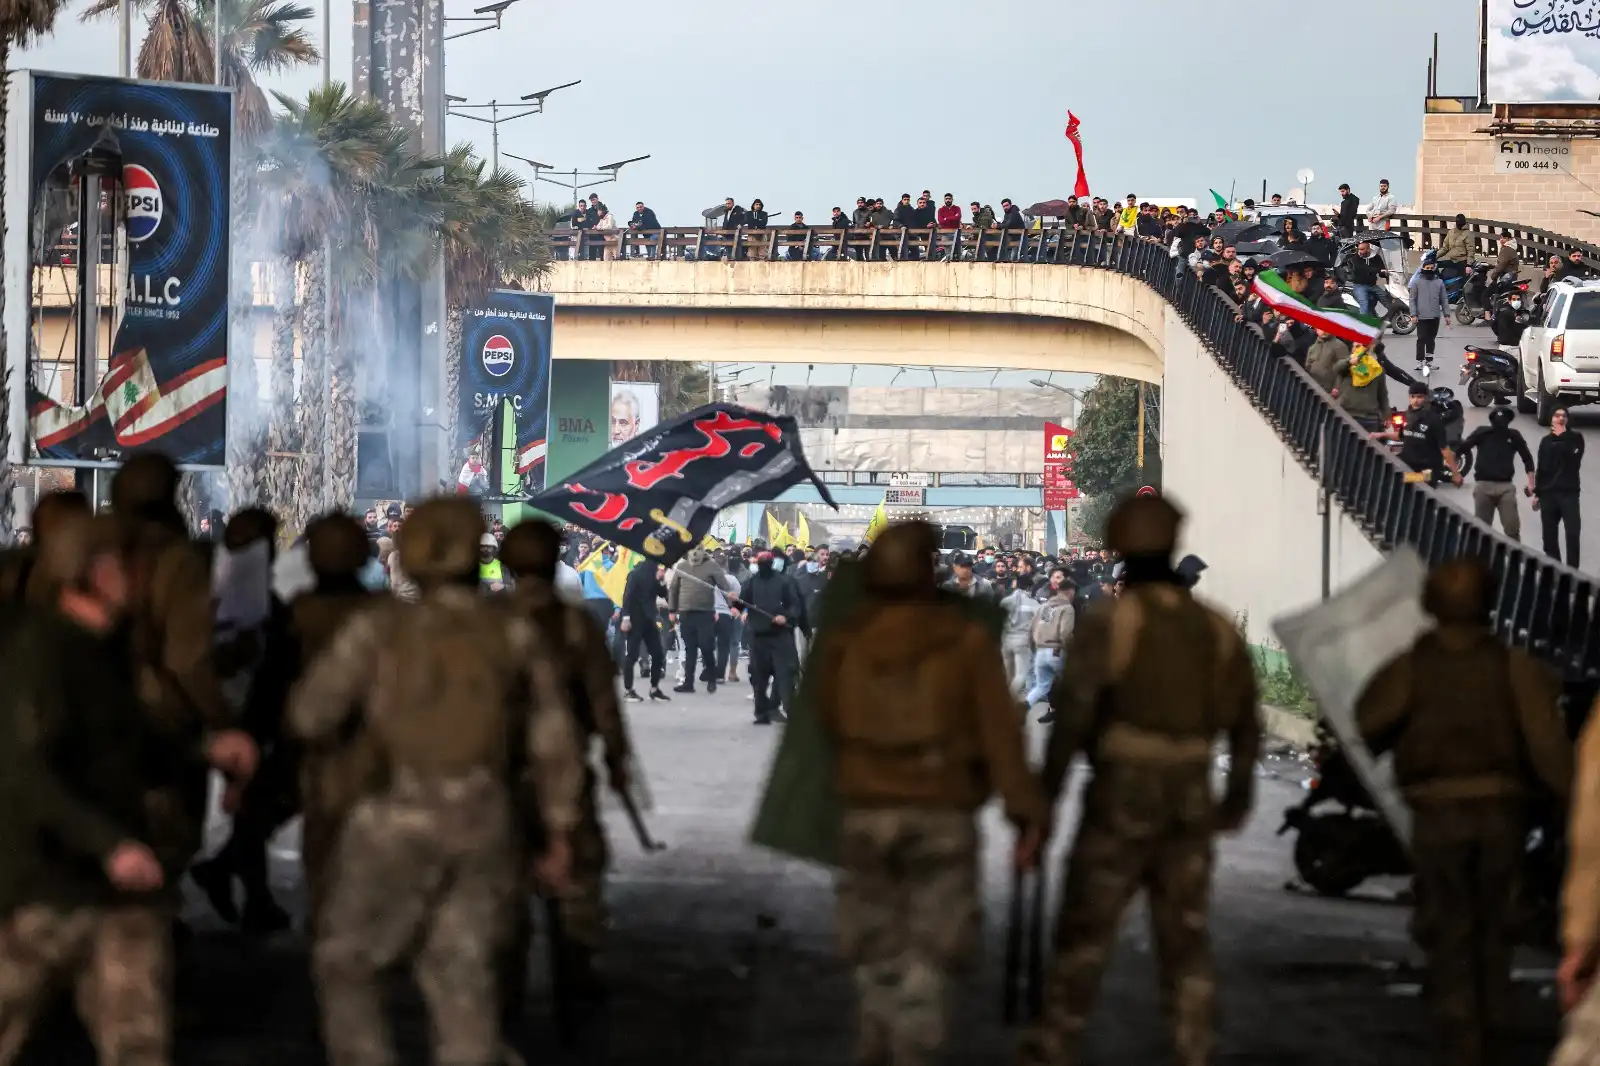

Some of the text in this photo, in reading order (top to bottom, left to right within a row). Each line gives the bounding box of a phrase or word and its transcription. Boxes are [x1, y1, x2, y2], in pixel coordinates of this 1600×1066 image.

[44, 108, 68, 124] سنة
[130, 116, 149, 132] منذ
[151, 118, 185, 137] لبنانية
[187, 121, 220, 138] صناعة
[1533, 146, 1569, 155] media
[1506, 160, 1559, 170] 7 000 444 9
[125, 195, 159, 212] EPSI
[144, 307, 164, 318] SINCE
[165, 310, 180, 319] 1952
[484, 350, 512, 361] PEPSI
[558, 417, 596, 434] BMA
